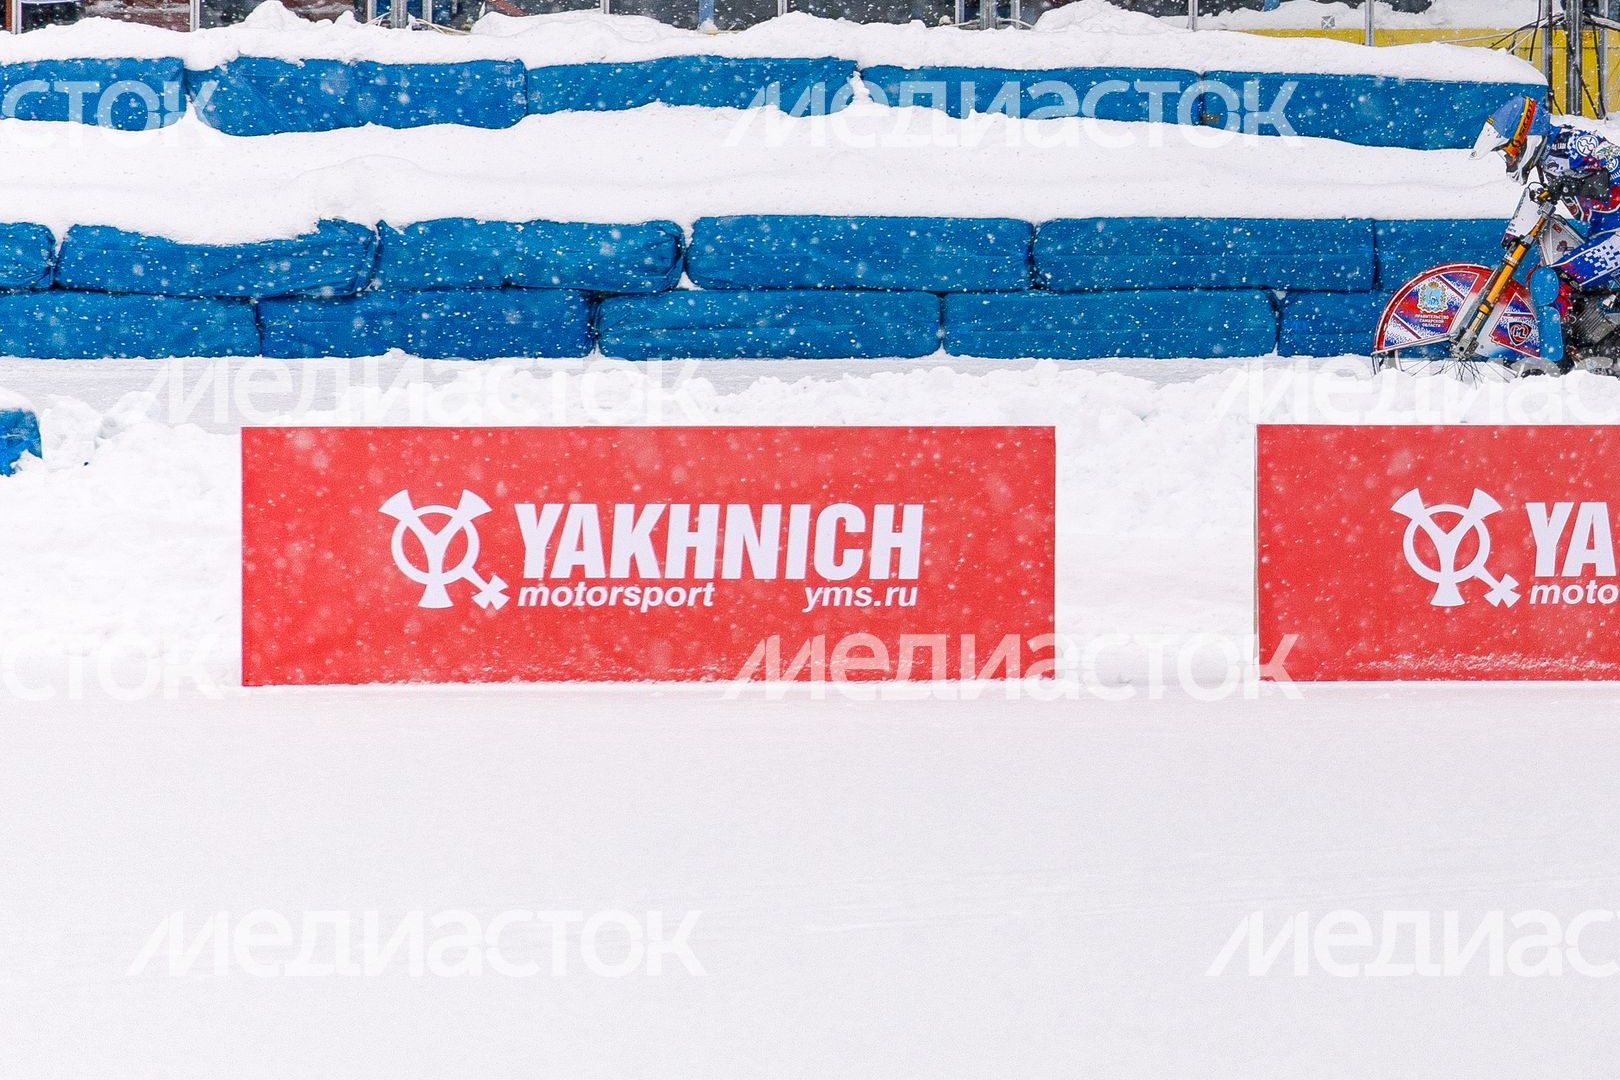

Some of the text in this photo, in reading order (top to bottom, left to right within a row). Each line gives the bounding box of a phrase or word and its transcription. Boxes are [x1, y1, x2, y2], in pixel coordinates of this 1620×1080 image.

[515, 502, 924, 581] YAKHNICH
[518, 581, 919, 613] motorsport yms.ru
